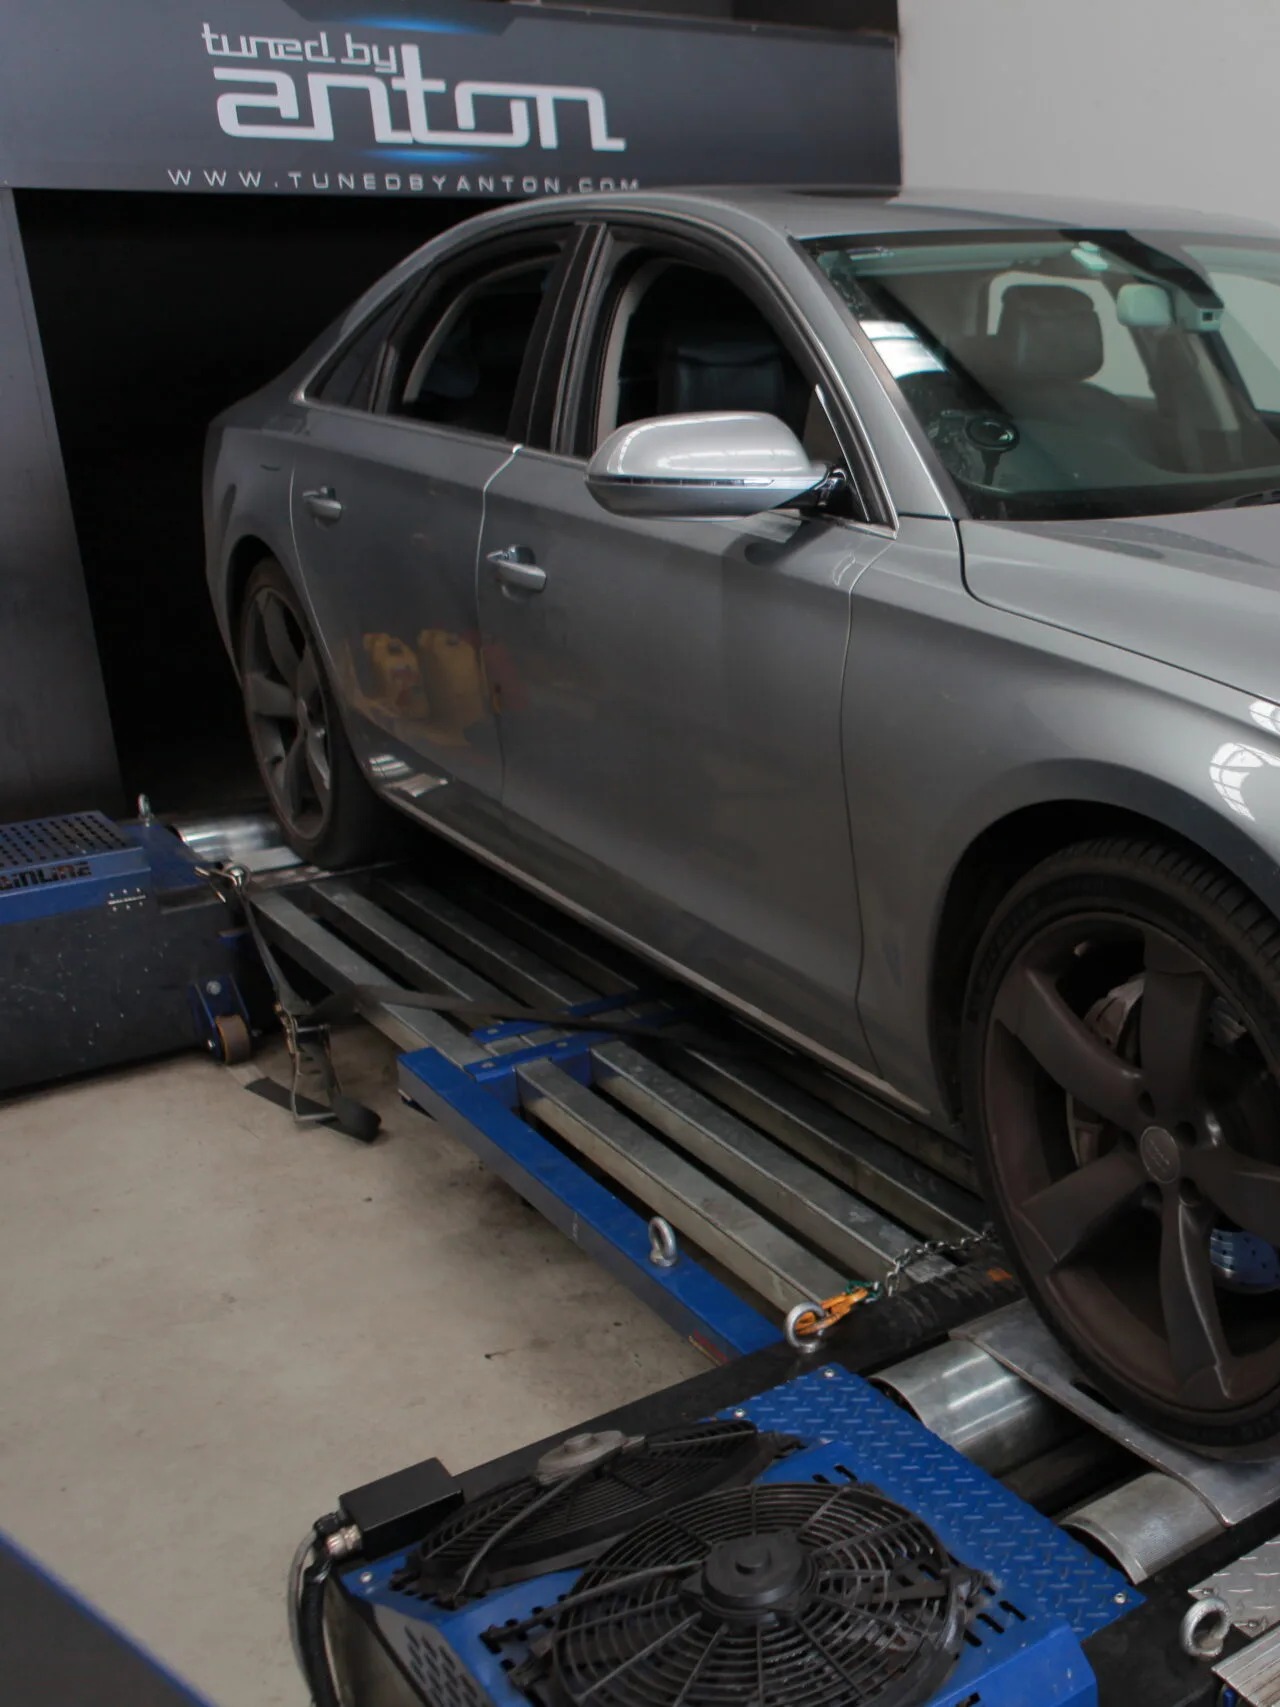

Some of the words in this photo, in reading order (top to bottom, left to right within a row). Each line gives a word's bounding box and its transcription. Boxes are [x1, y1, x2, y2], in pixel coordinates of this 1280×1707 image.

[201, 22, 336, 63] tuned
[340, 32, 398, 73] by
[213, 43, 626, 152] anton
